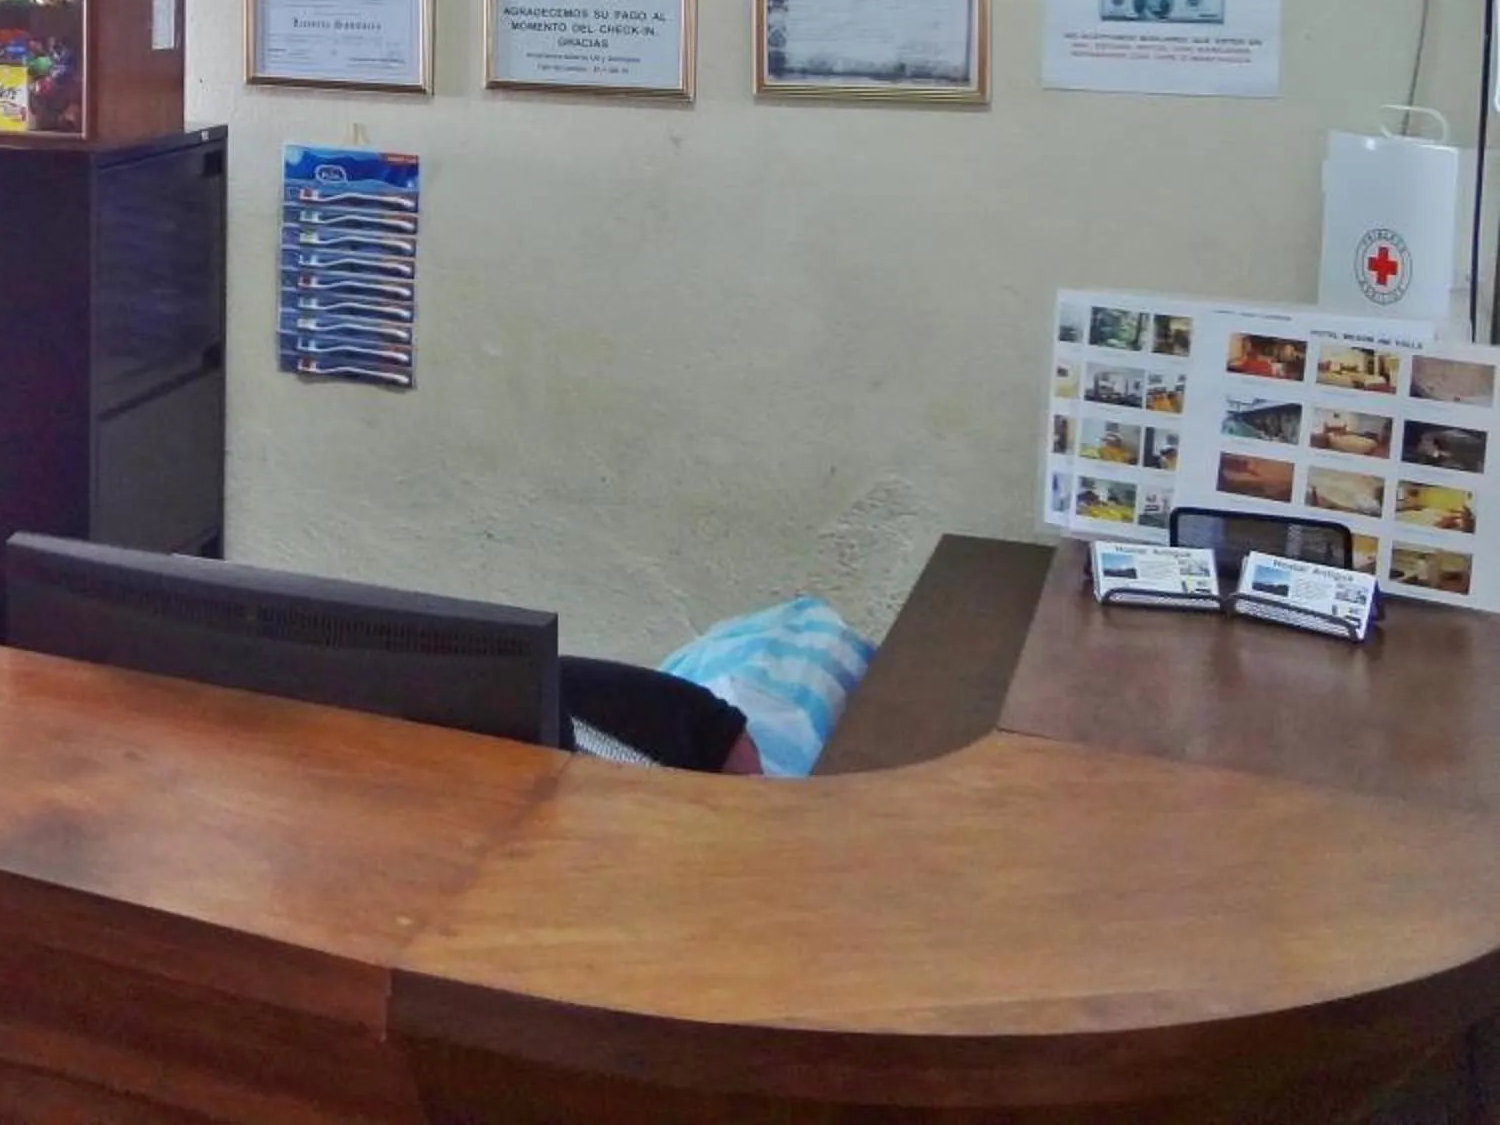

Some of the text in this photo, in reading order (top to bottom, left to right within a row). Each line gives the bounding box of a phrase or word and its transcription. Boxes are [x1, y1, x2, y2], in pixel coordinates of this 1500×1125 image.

[503, 7, 589, 19] AGRADECEMOS
[594, 10, 609, 20] SU
[614, 11, 647, 20] PAGO
[512, 21, 567, 32] MOMENTO
[571, 24, 594, 35] DEL
[558, 36, 609, 49] GRACIAS
